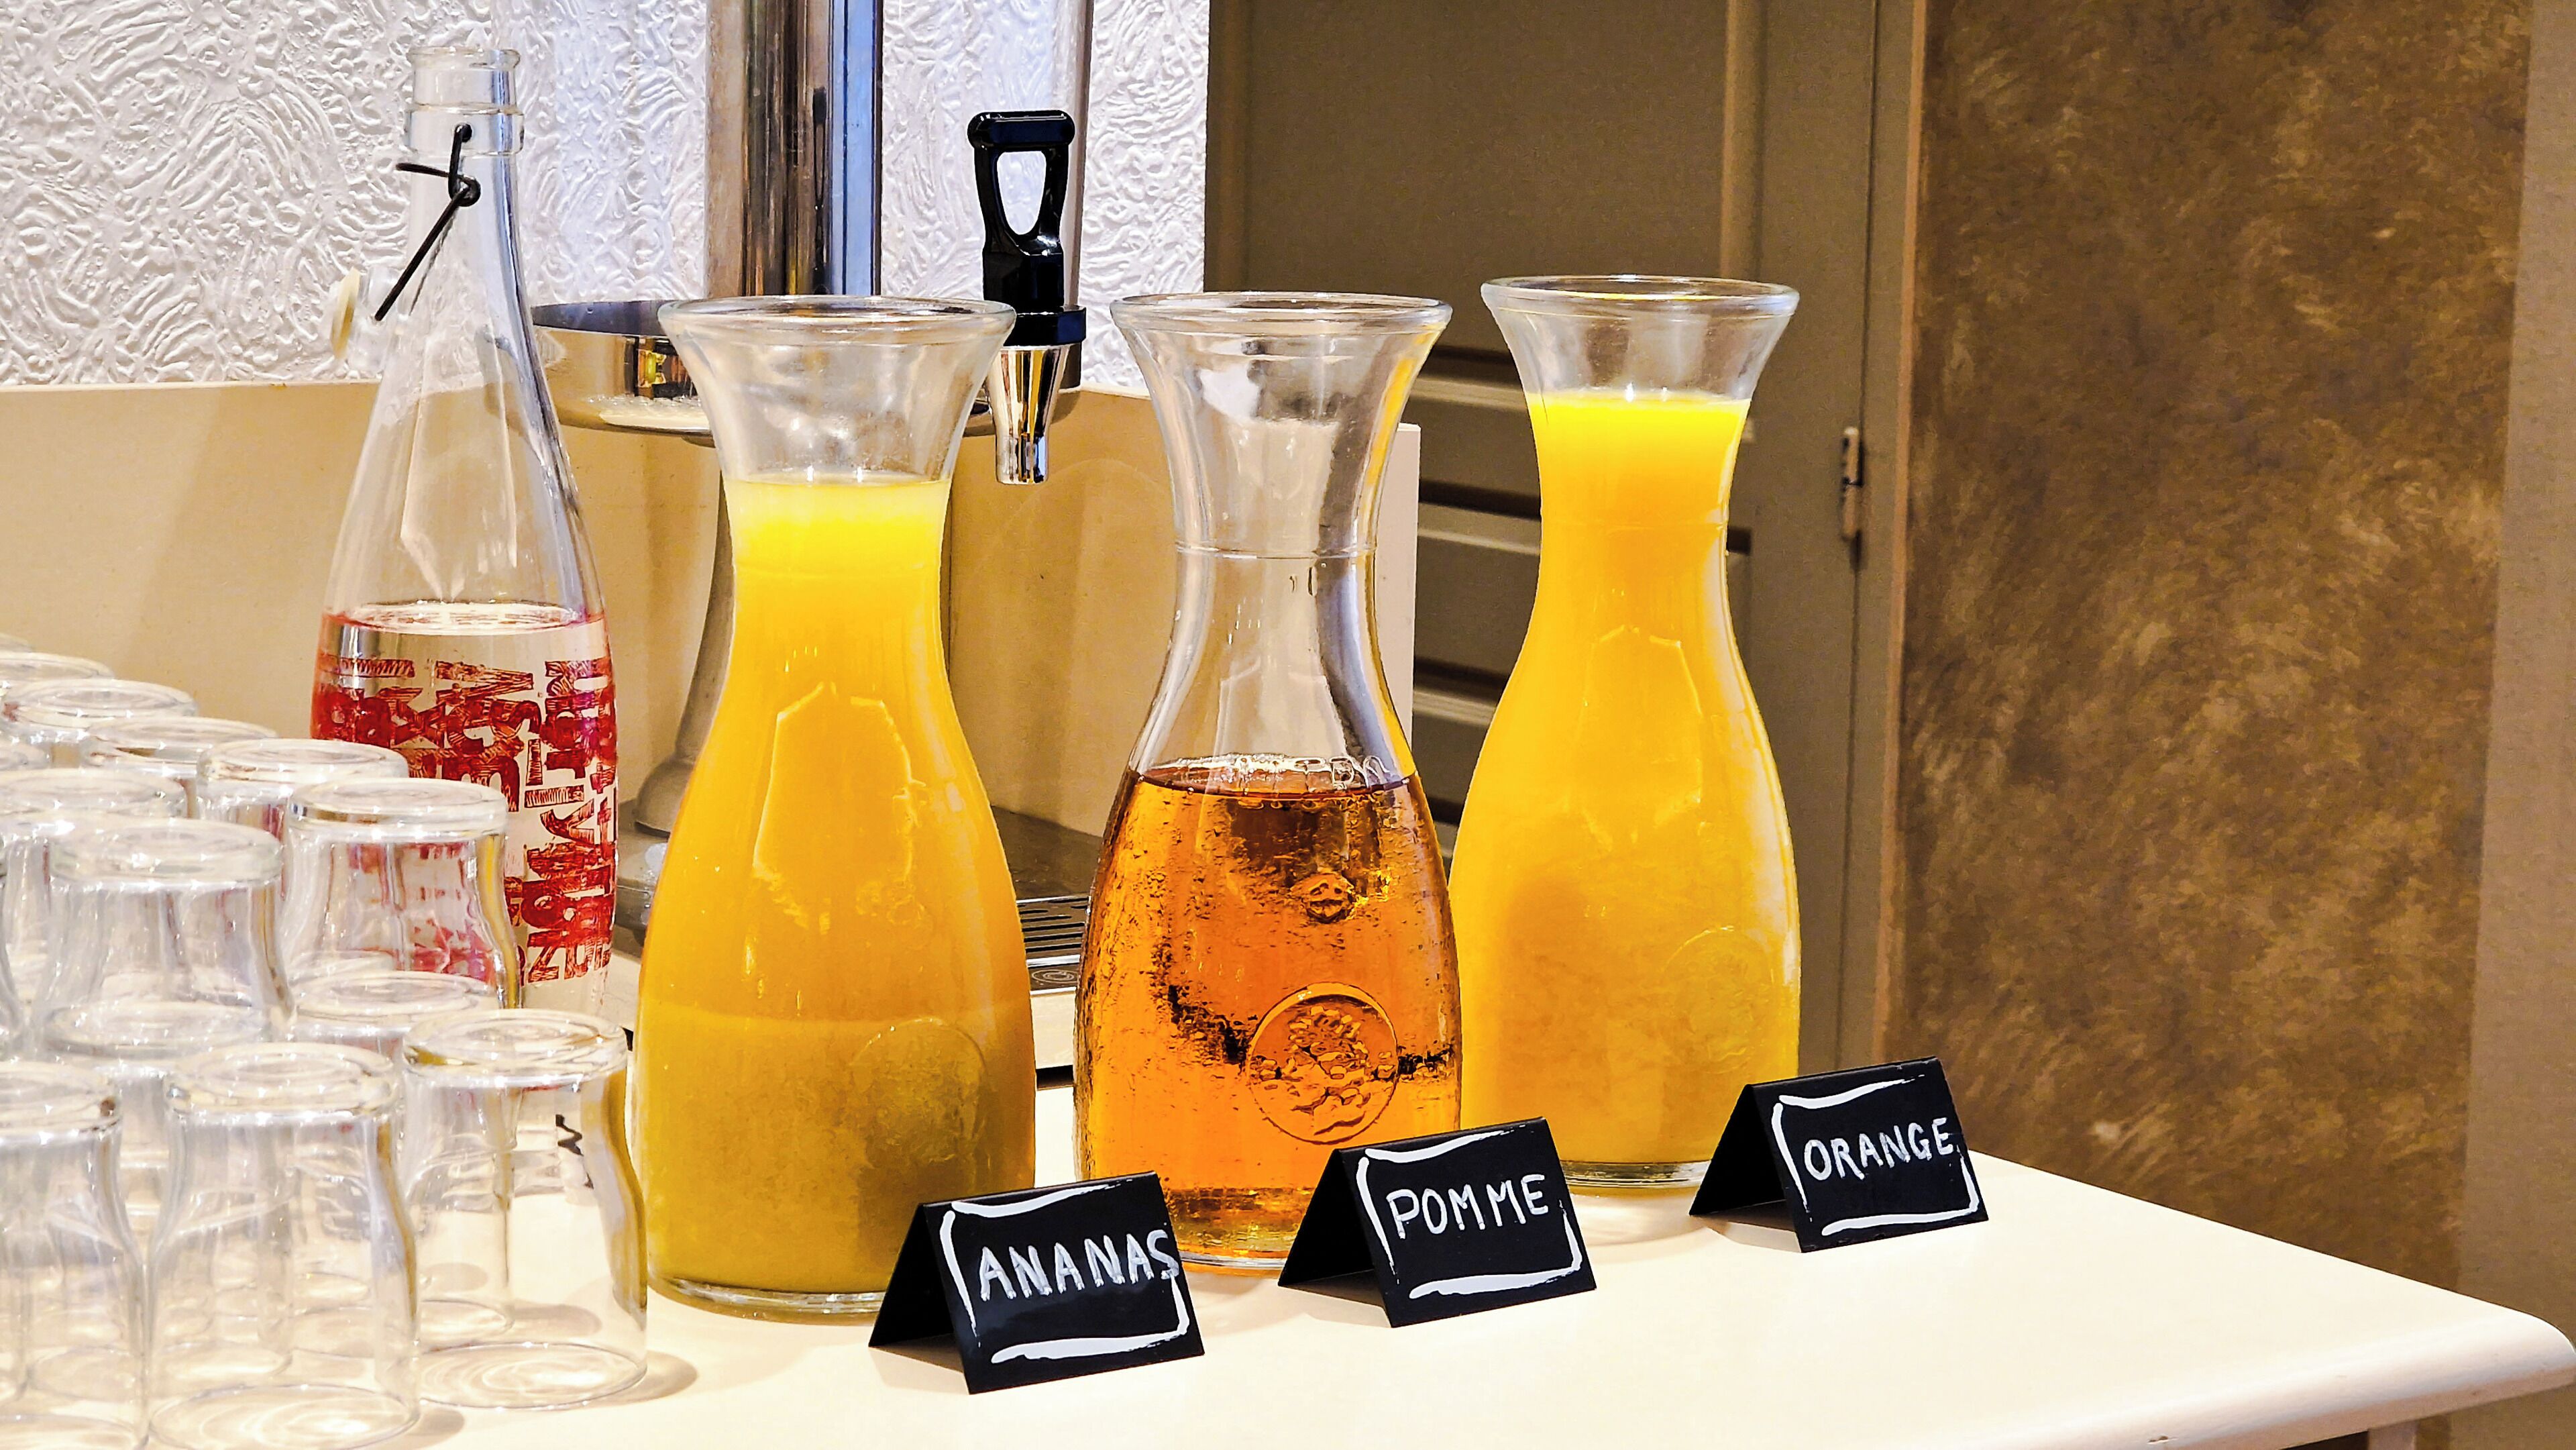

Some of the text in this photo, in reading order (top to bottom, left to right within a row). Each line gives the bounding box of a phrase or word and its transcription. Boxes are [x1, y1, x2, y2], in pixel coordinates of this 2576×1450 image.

[1804, 1117, 1953, 1181] ORANGE
[1386, 1174, 1549, 1239] POMME
[979, 1229, 1179, 1302] ANANAS
